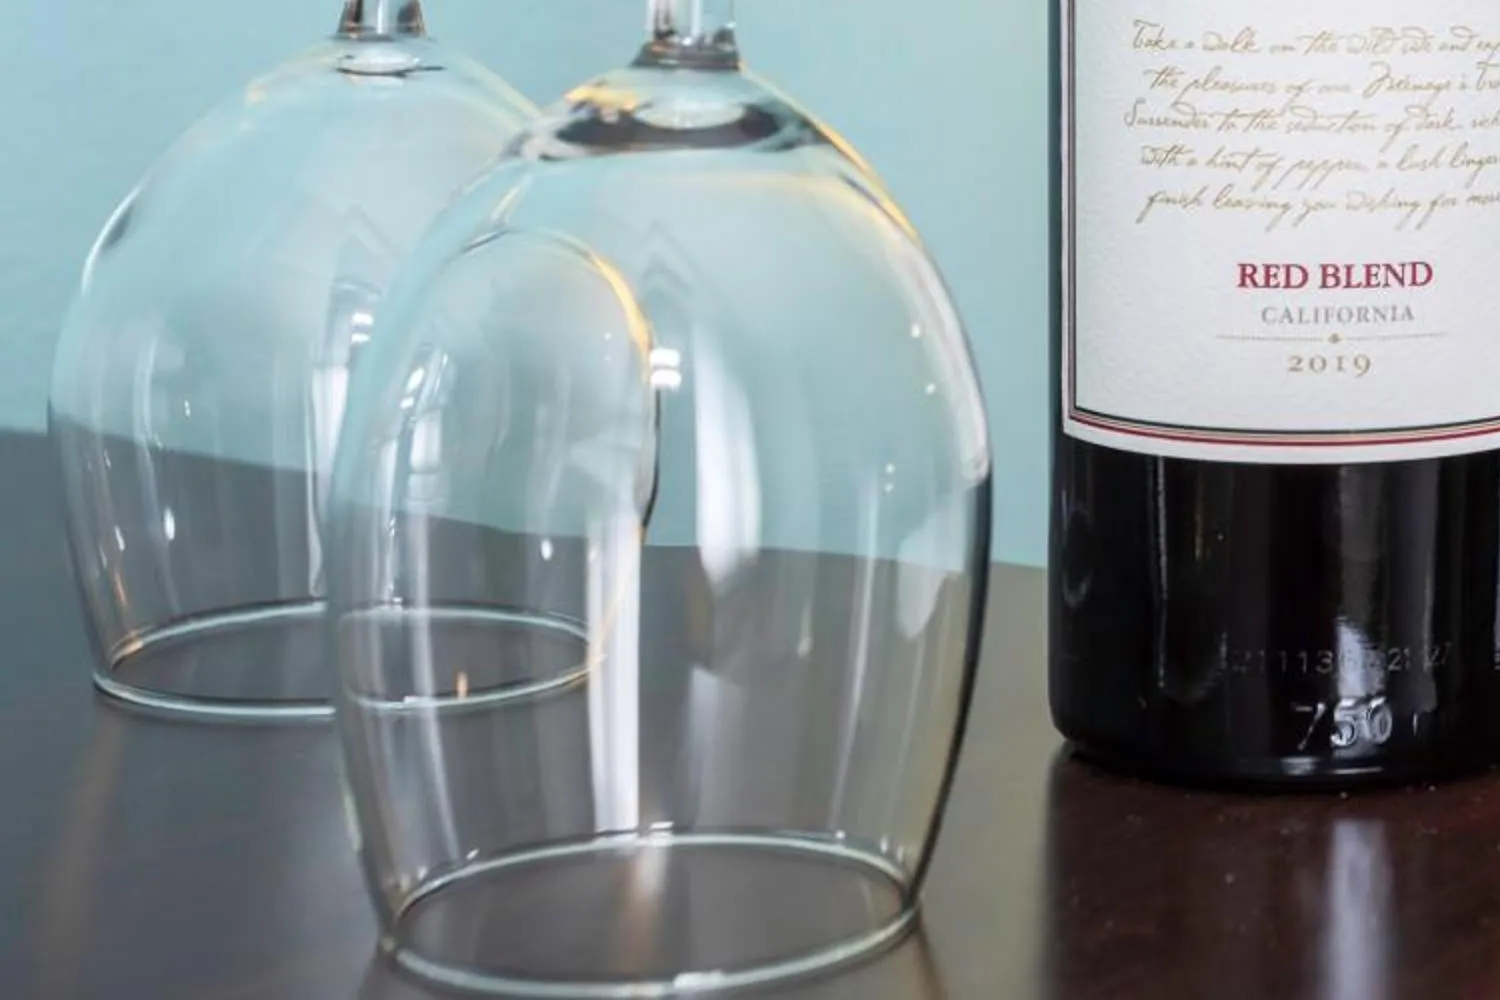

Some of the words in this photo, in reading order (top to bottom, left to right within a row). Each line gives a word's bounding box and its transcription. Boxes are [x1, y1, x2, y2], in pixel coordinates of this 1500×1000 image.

[1133, 19, 1177, 50] Take
[1296, 31, 1338, 56] the
[1438, 25, 1480, 51] and
[1143, 65, 1184, 90] the
[1123, 97, 1208, 130] Surrender
[1212, 108, 1240, 132] to
[1243, 108, 1281, 133] the
[1140, 144, 1194, 168] with
[1205, 146, 1276, 173] hint
[1251, 156, 1285, 192] of
[1396, 143, 1446, 172] lush
[1136, 185, 1209, 225] finish
[1212, 183, 1292, 234] leaving
[1414, 191, 1458, 231] for
[1236, 262, 1309, 289] RED
[1319, 260, 1434, 289] BLEND
[1260, 304, 1416, 326] CALIFORNIA
[1287, 353, 1373, 378] 2019
